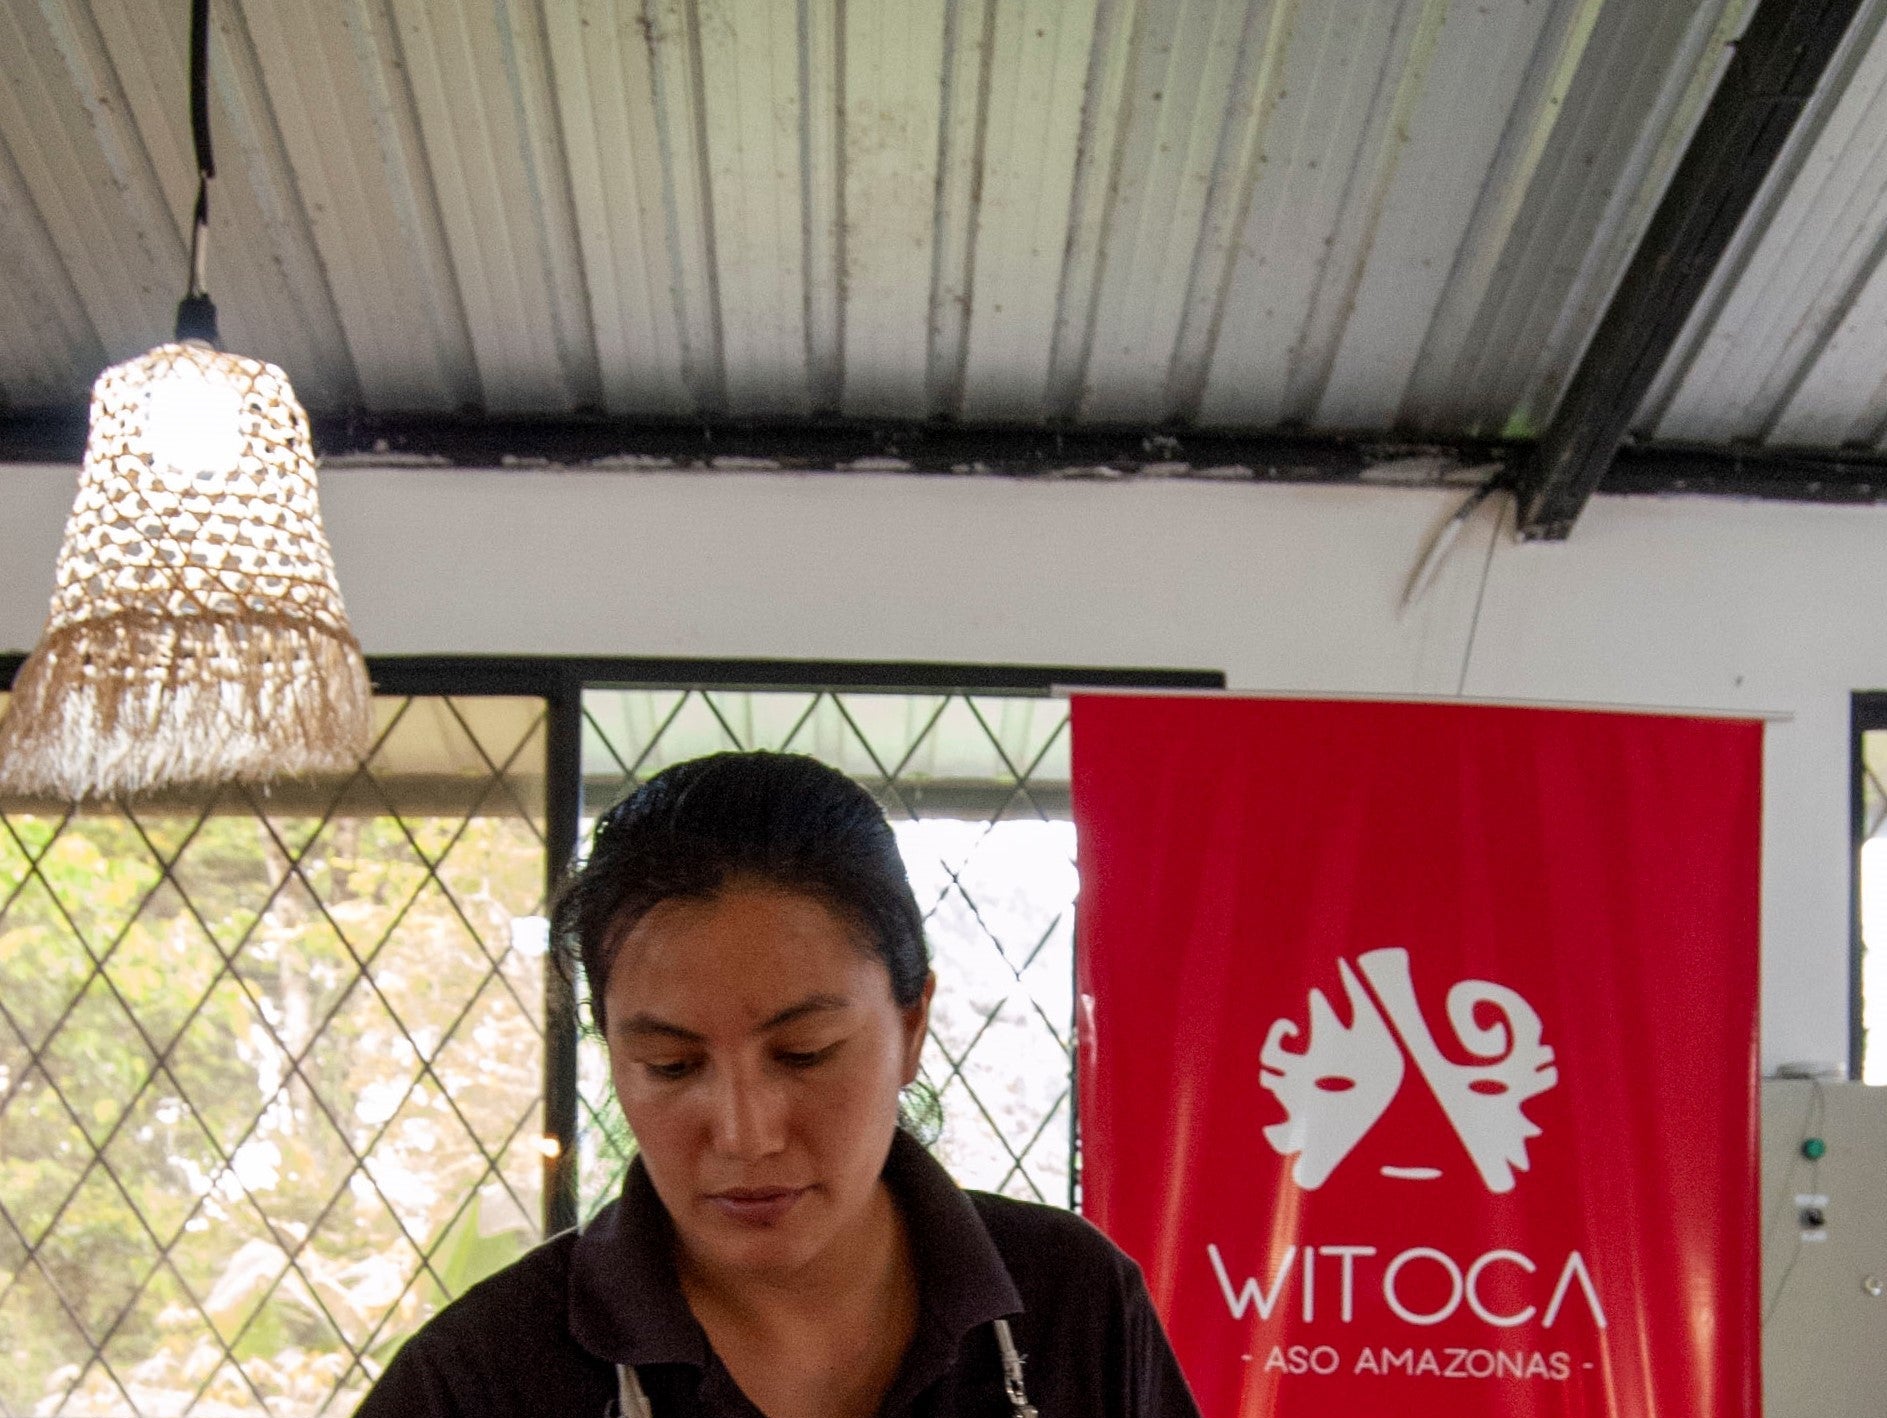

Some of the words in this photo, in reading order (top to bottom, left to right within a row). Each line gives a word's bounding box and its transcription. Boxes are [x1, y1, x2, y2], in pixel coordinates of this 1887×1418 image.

[1206, 1242, 1607, 1329] WITOCA
[1264, 1345, 1340, 1375] ASO
[1354, 1347, 1571, 1381] AMAZONAS
